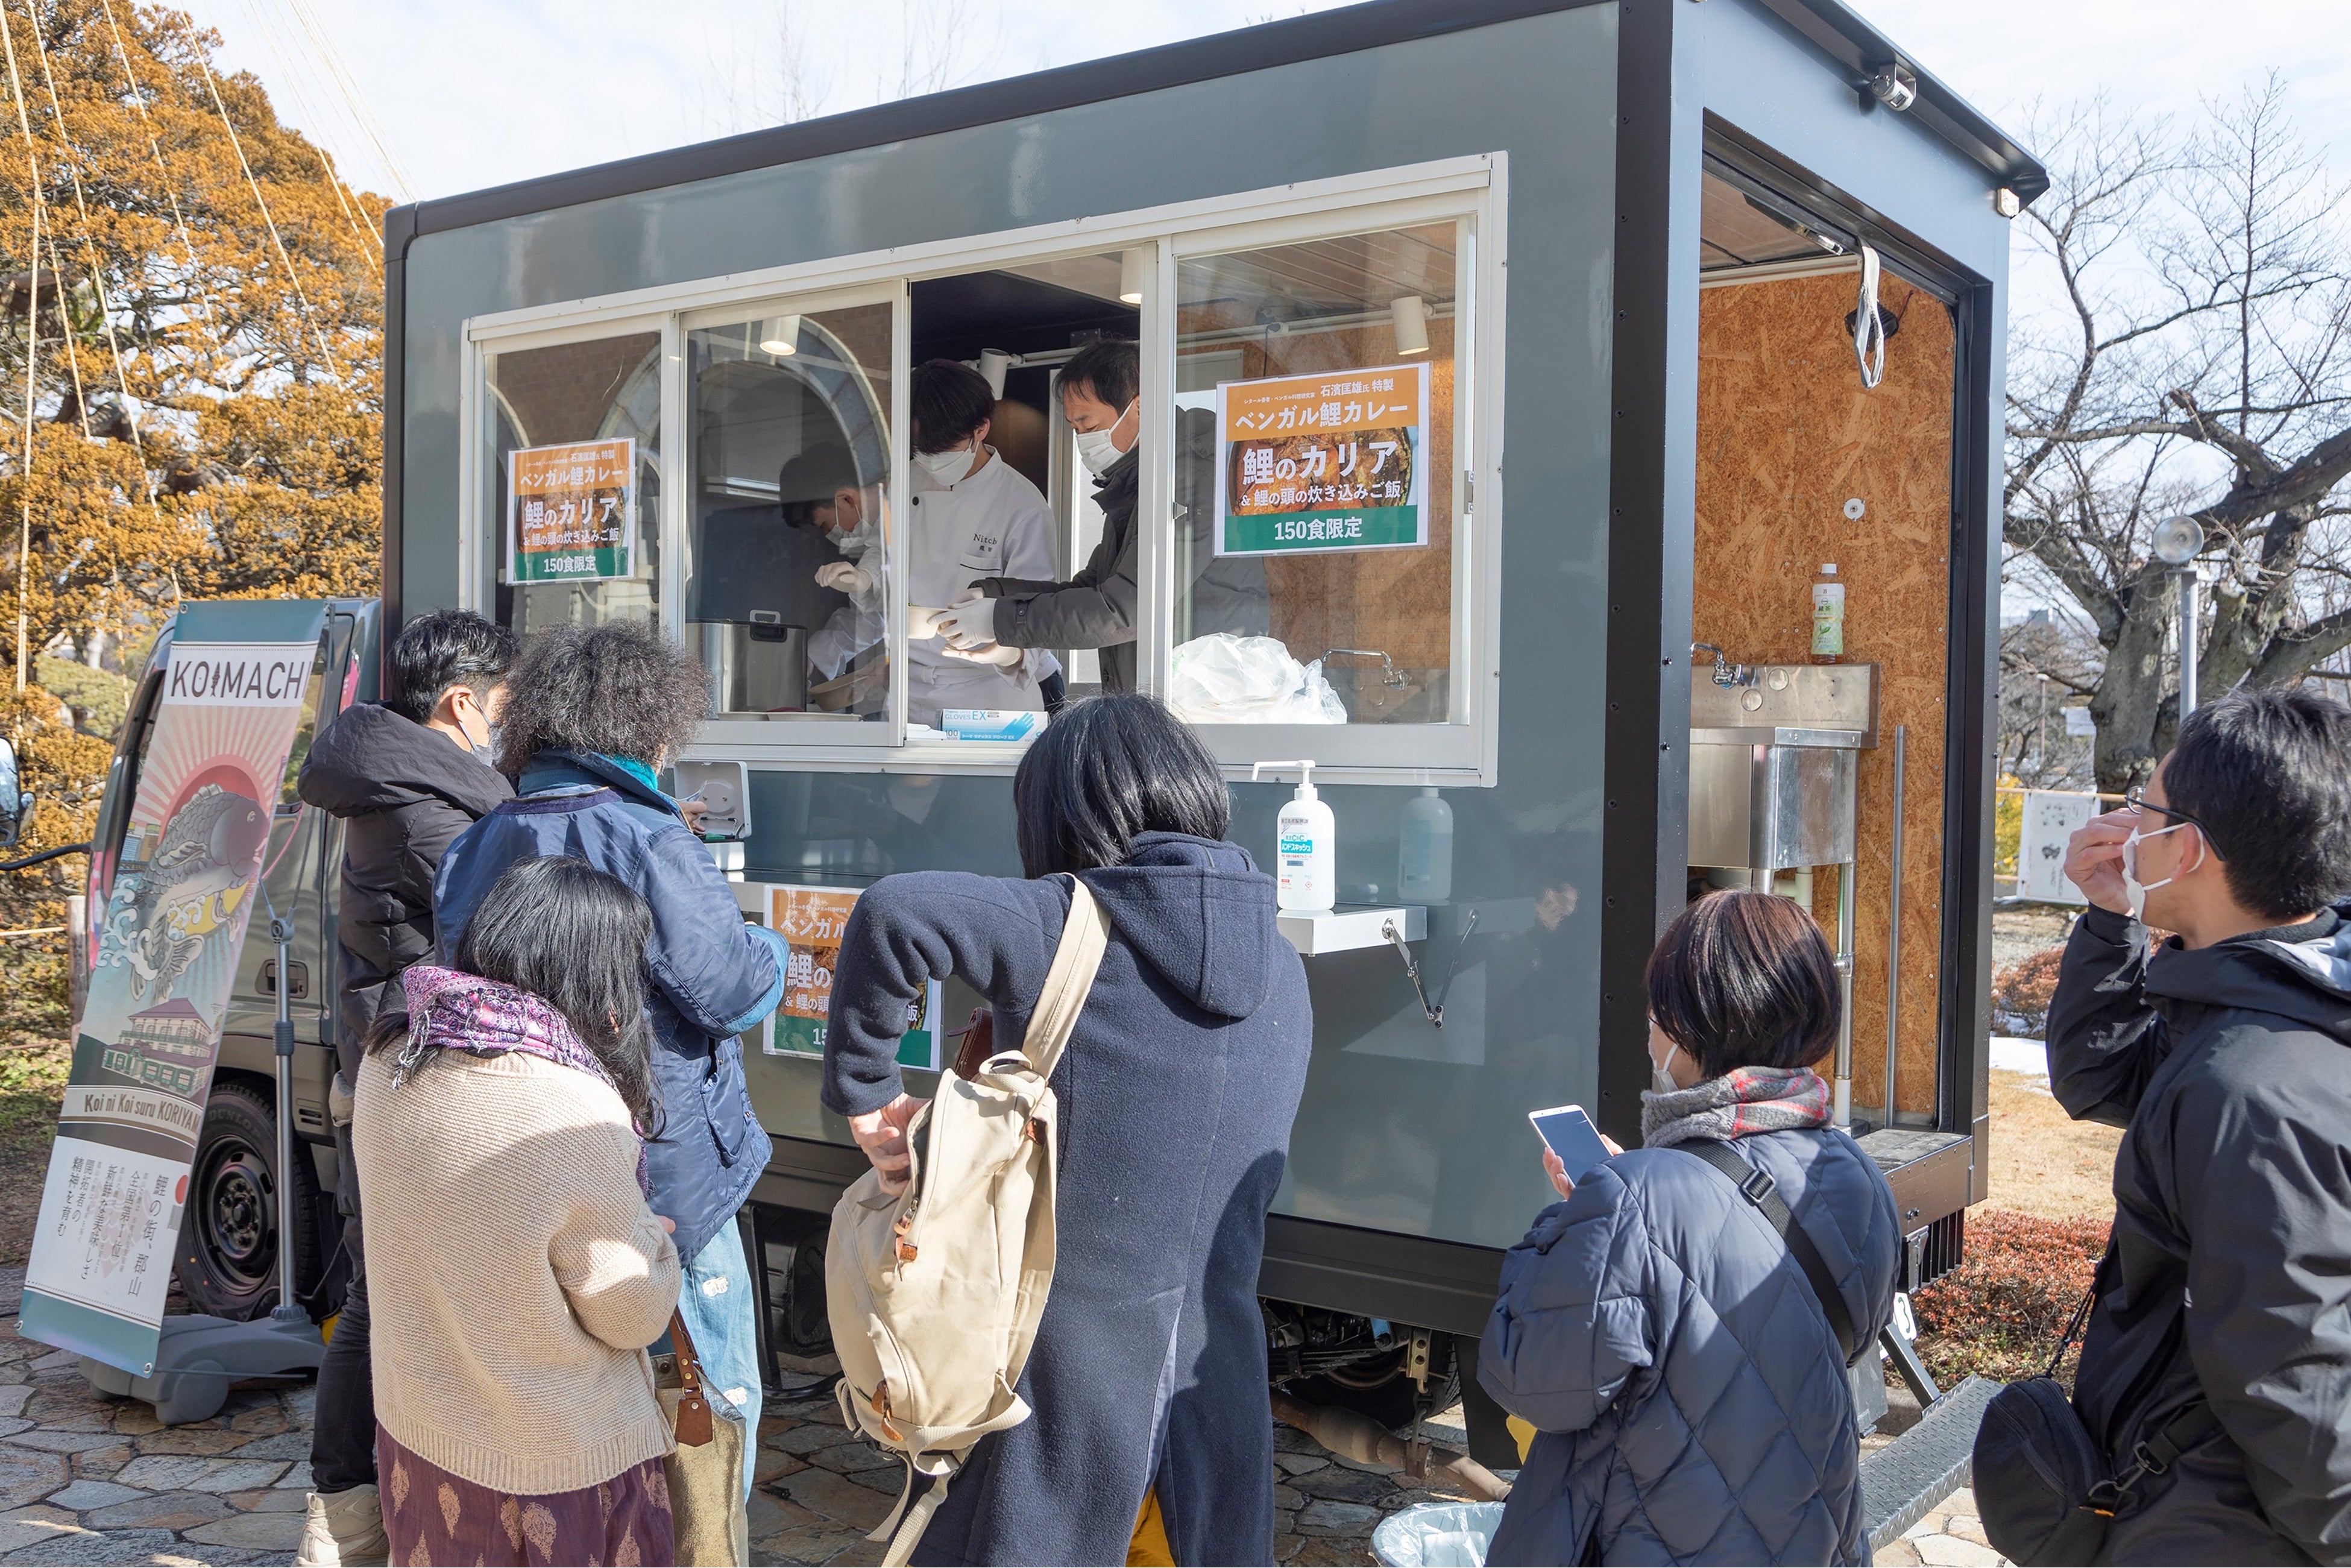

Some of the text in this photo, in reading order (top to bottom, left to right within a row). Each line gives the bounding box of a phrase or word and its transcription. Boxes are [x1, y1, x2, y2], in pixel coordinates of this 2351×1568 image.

[1371, 378, 1394, 392] 特製
[1235, 400, 1408, 430] ベンガル鯉カレー
[1242, 441, 1398, 485] 鯉のカリア
[520, 466, 623, 488] ベンガル鯉カレー
[1241, 480, 1401, 507] & 鯉の頭の炊き込みご飯
[524, 497, 617, 530] 鯉のカリア
[532, 527, 619, 547] 鯉の頭の炊き込みご飯
[1274, 517, 1363, 541] 150食限定
[544, 554, 596, 573] 150食限定
[972, 711, 986, 720] EX
[787, 951, 831, 989] 鯉の
[785, 996, 793, 1007] &
[84, 1094, 105, 1113] Koi
[105, 1094, 117, 1112] ni
[118, 1094, 135, 1113] Koi
[135, 1101, 156, 1117] suru
[57, 1156, 84, 1237] 精神を育む
[72, 1159, 95, 1223] 開拓者の
[81, 1165, 118, 1280] 新鮮な美味しさ
[128, 1174, 169, 1297] 鯉の街、郡山
